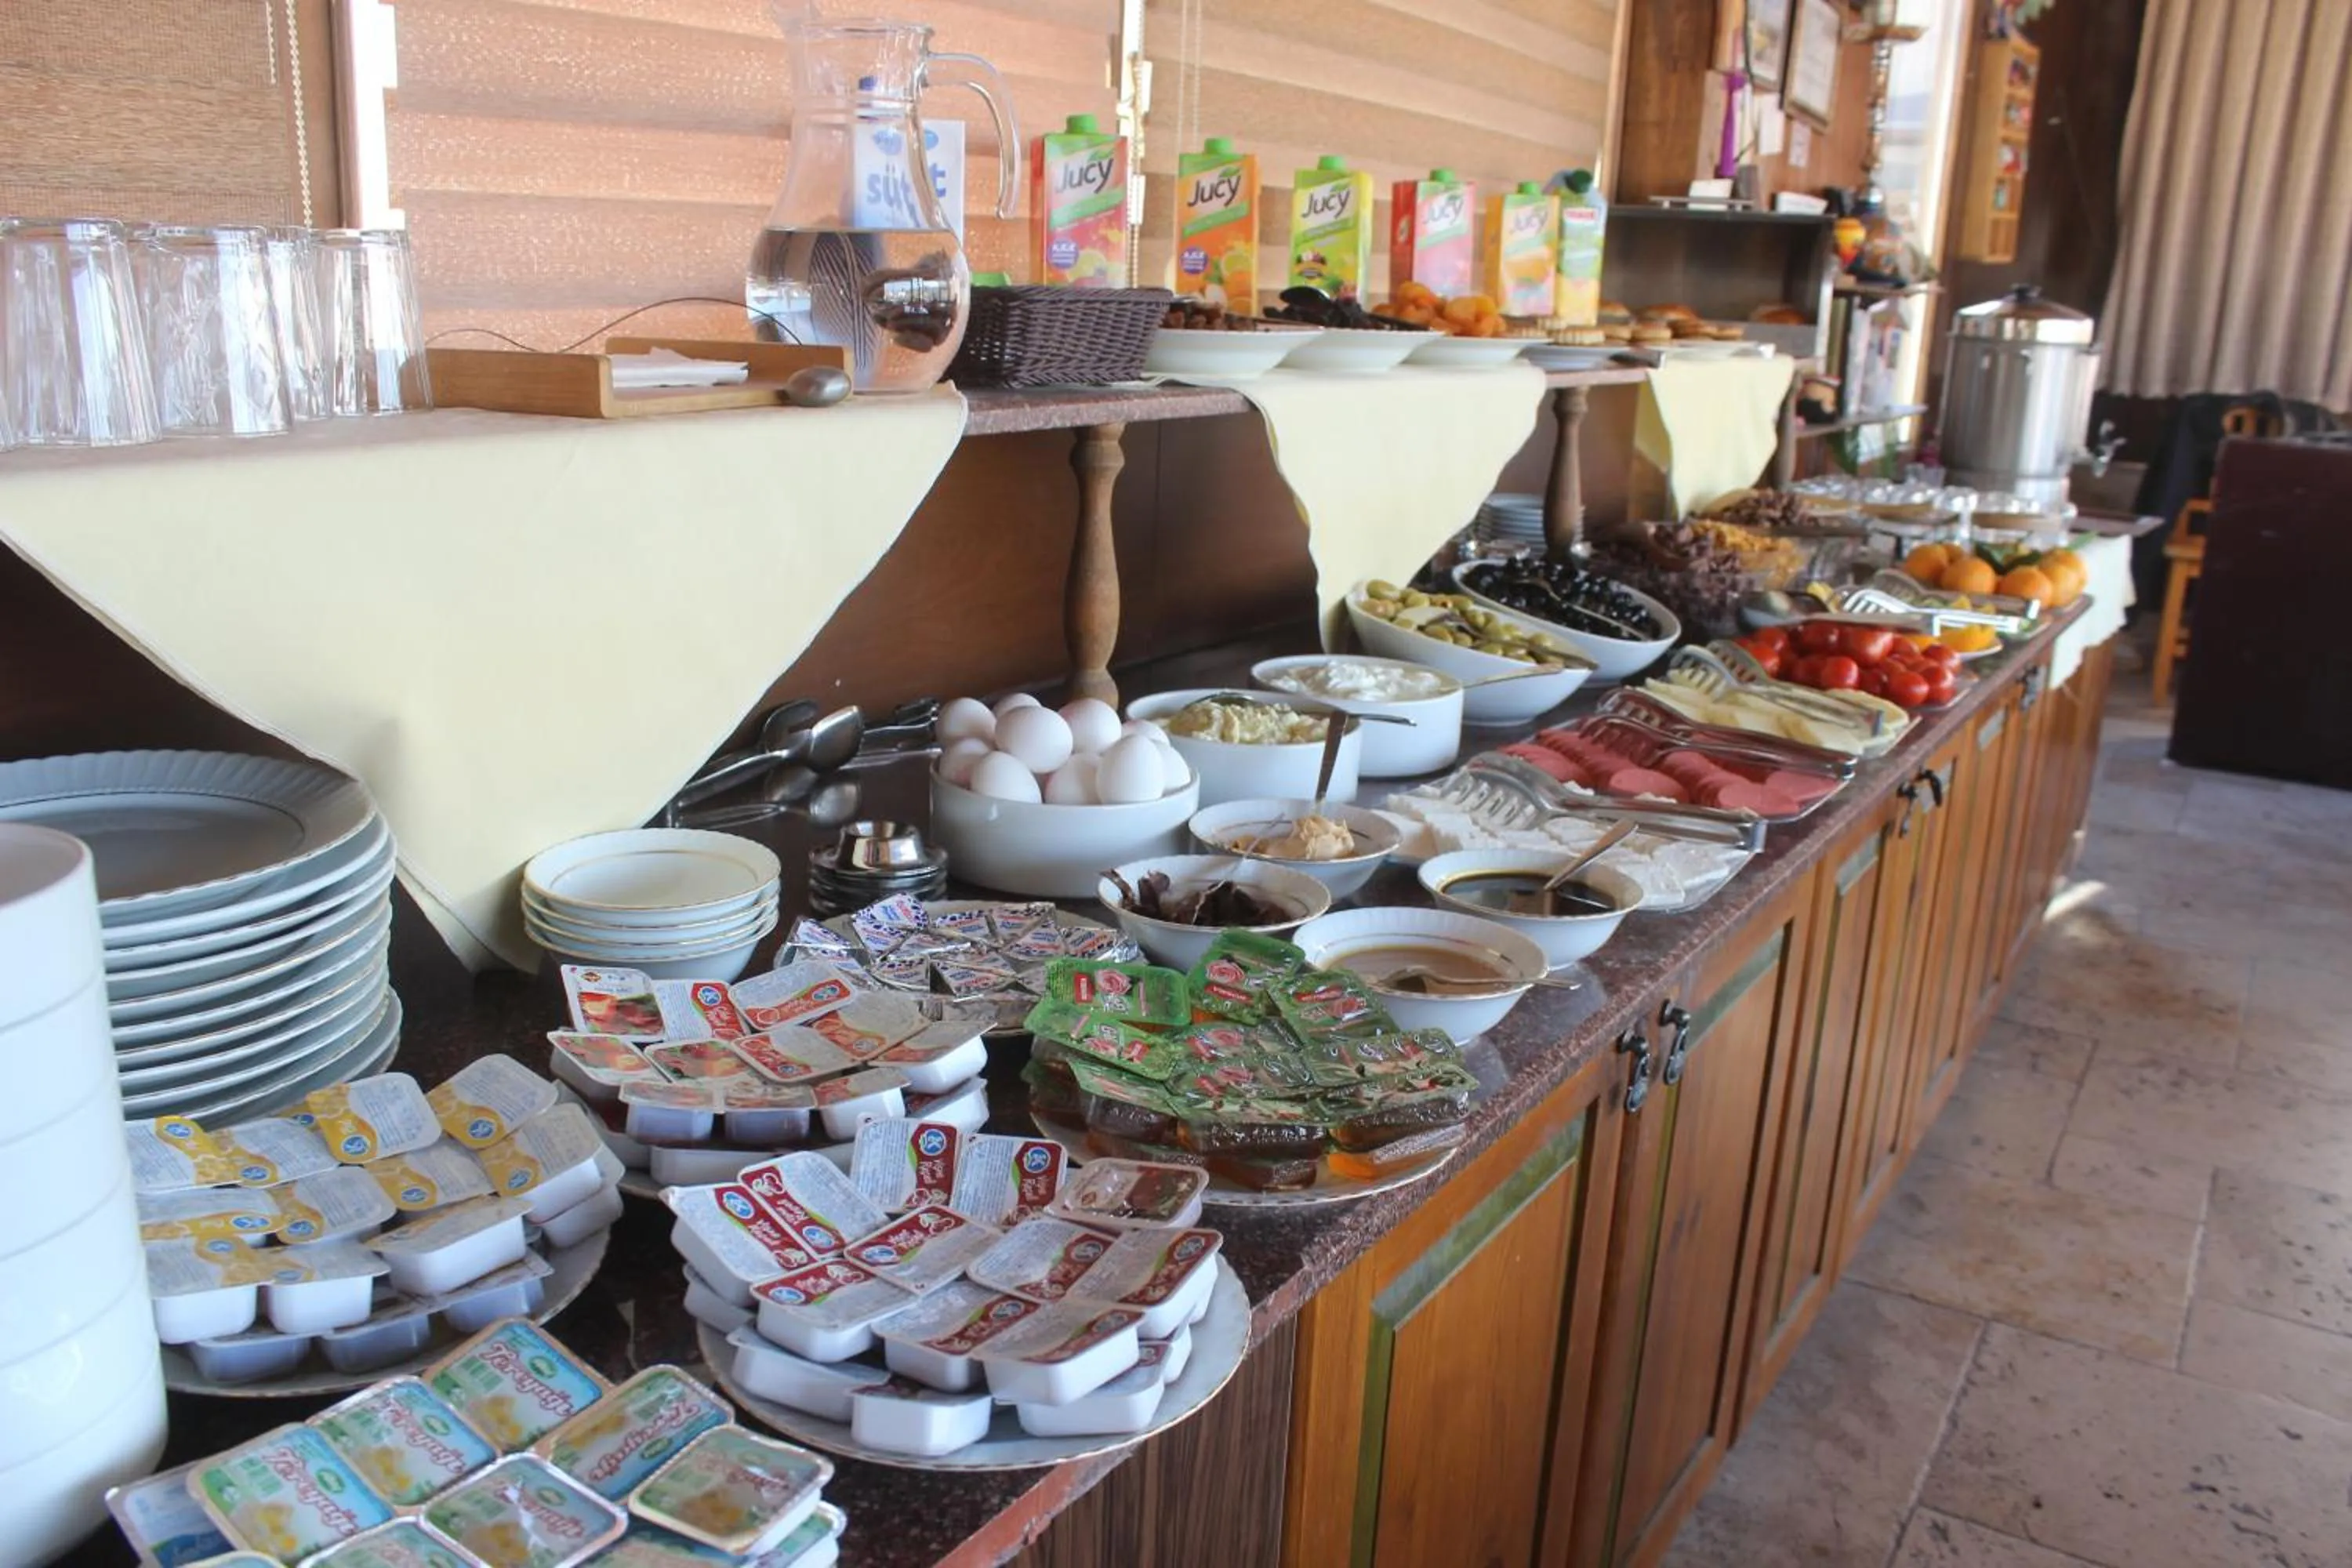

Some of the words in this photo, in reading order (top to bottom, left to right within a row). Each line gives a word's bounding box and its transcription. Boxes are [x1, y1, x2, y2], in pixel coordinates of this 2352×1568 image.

[1055, 157, 1114, 194] Jucy
[1187, 174, 1241, 209] Jucy
[1301, 188, 1351, 220] Jucy
